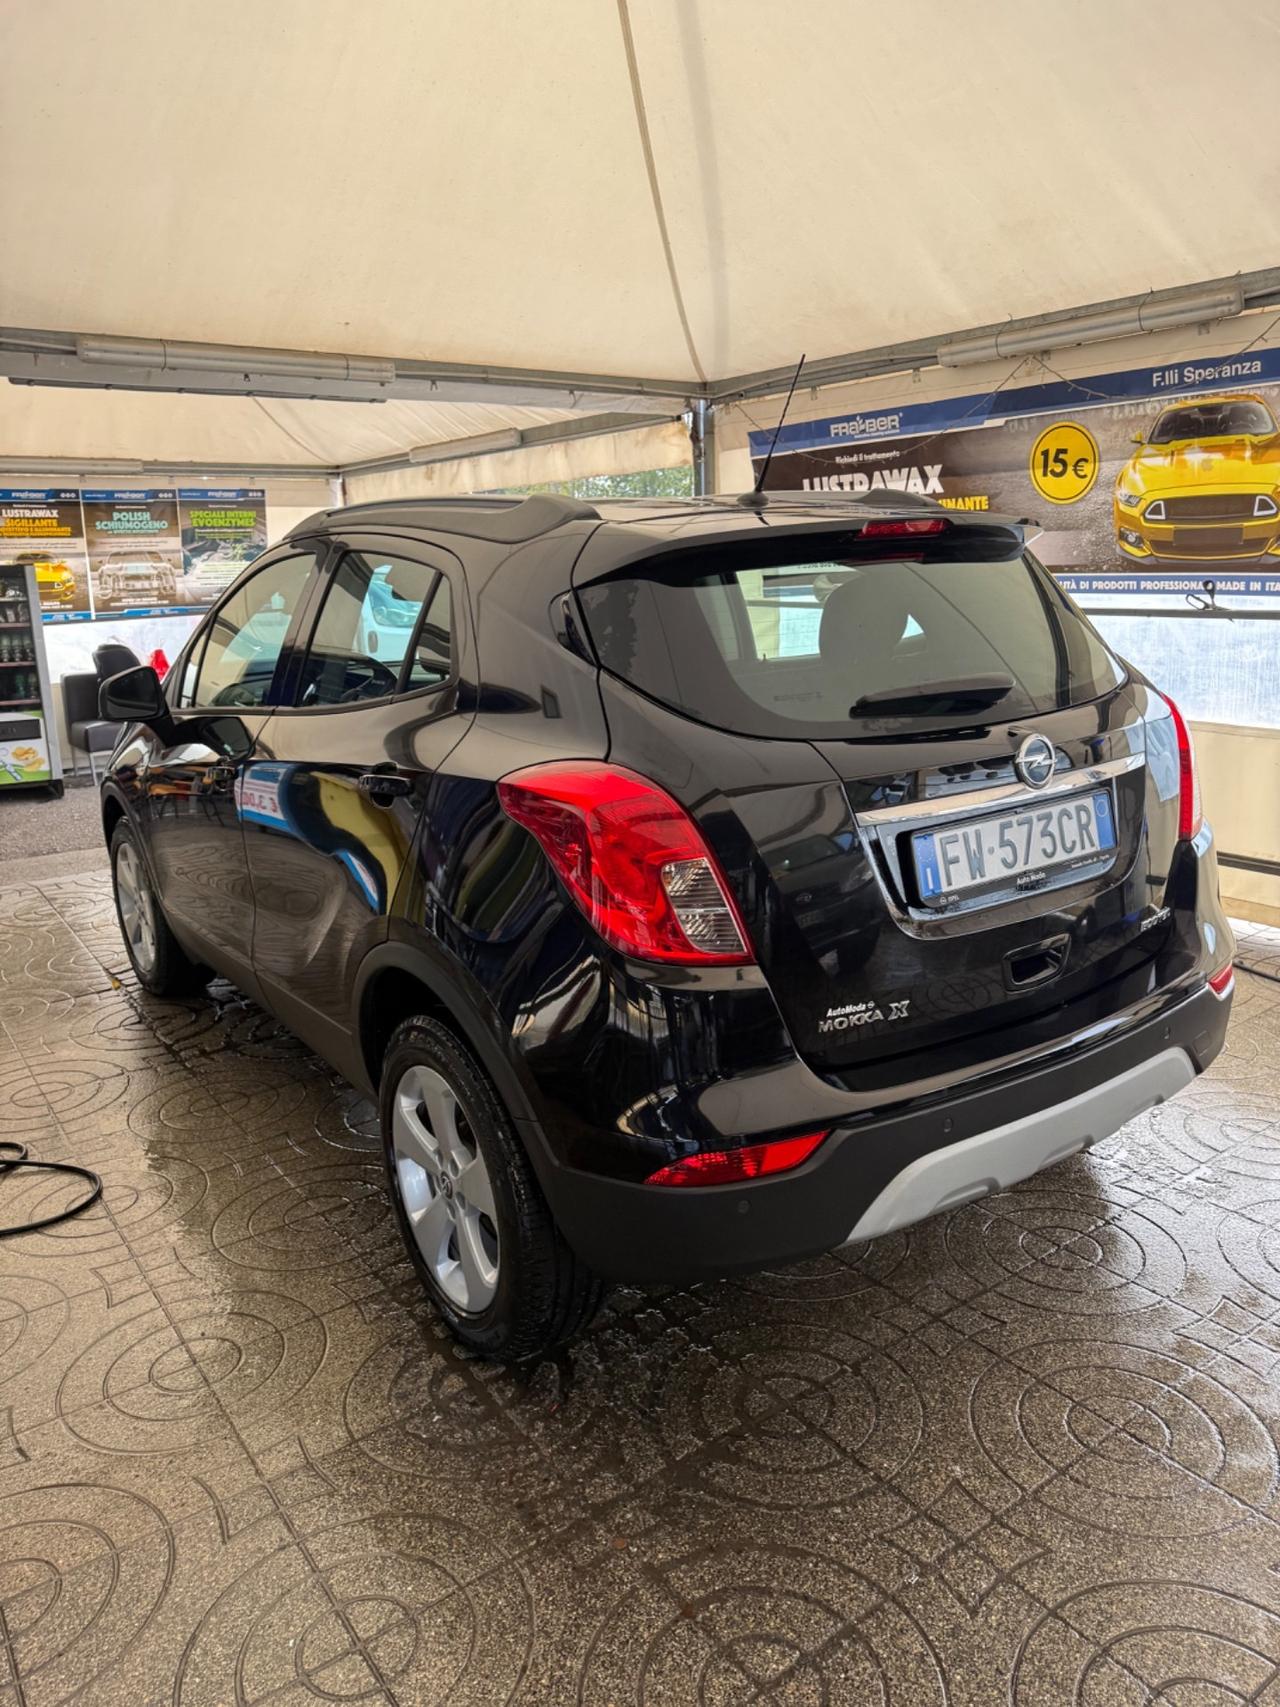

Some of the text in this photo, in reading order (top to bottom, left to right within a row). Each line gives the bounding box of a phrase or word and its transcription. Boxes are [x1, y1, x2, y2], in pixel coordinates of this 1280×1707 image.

[1184, 360, 1262, 384] Speranza
[2, 509, 59, 518] LUSTRAWAX
[112, 511, 150, 521] POLISH
[95, 520, 168, 530] SCHIUMOGENO
[1080, 580, 1089, 590] DI
[1092, 580, 1137, 590] PRODOTTI
[1140, 580, 1211, 591] PROFESSIONA
[1216, 581, 1246, 591] MADE
[1249, 582, 1262, 592] IN
[818, 1000, 910, 1033] MOKKA X
